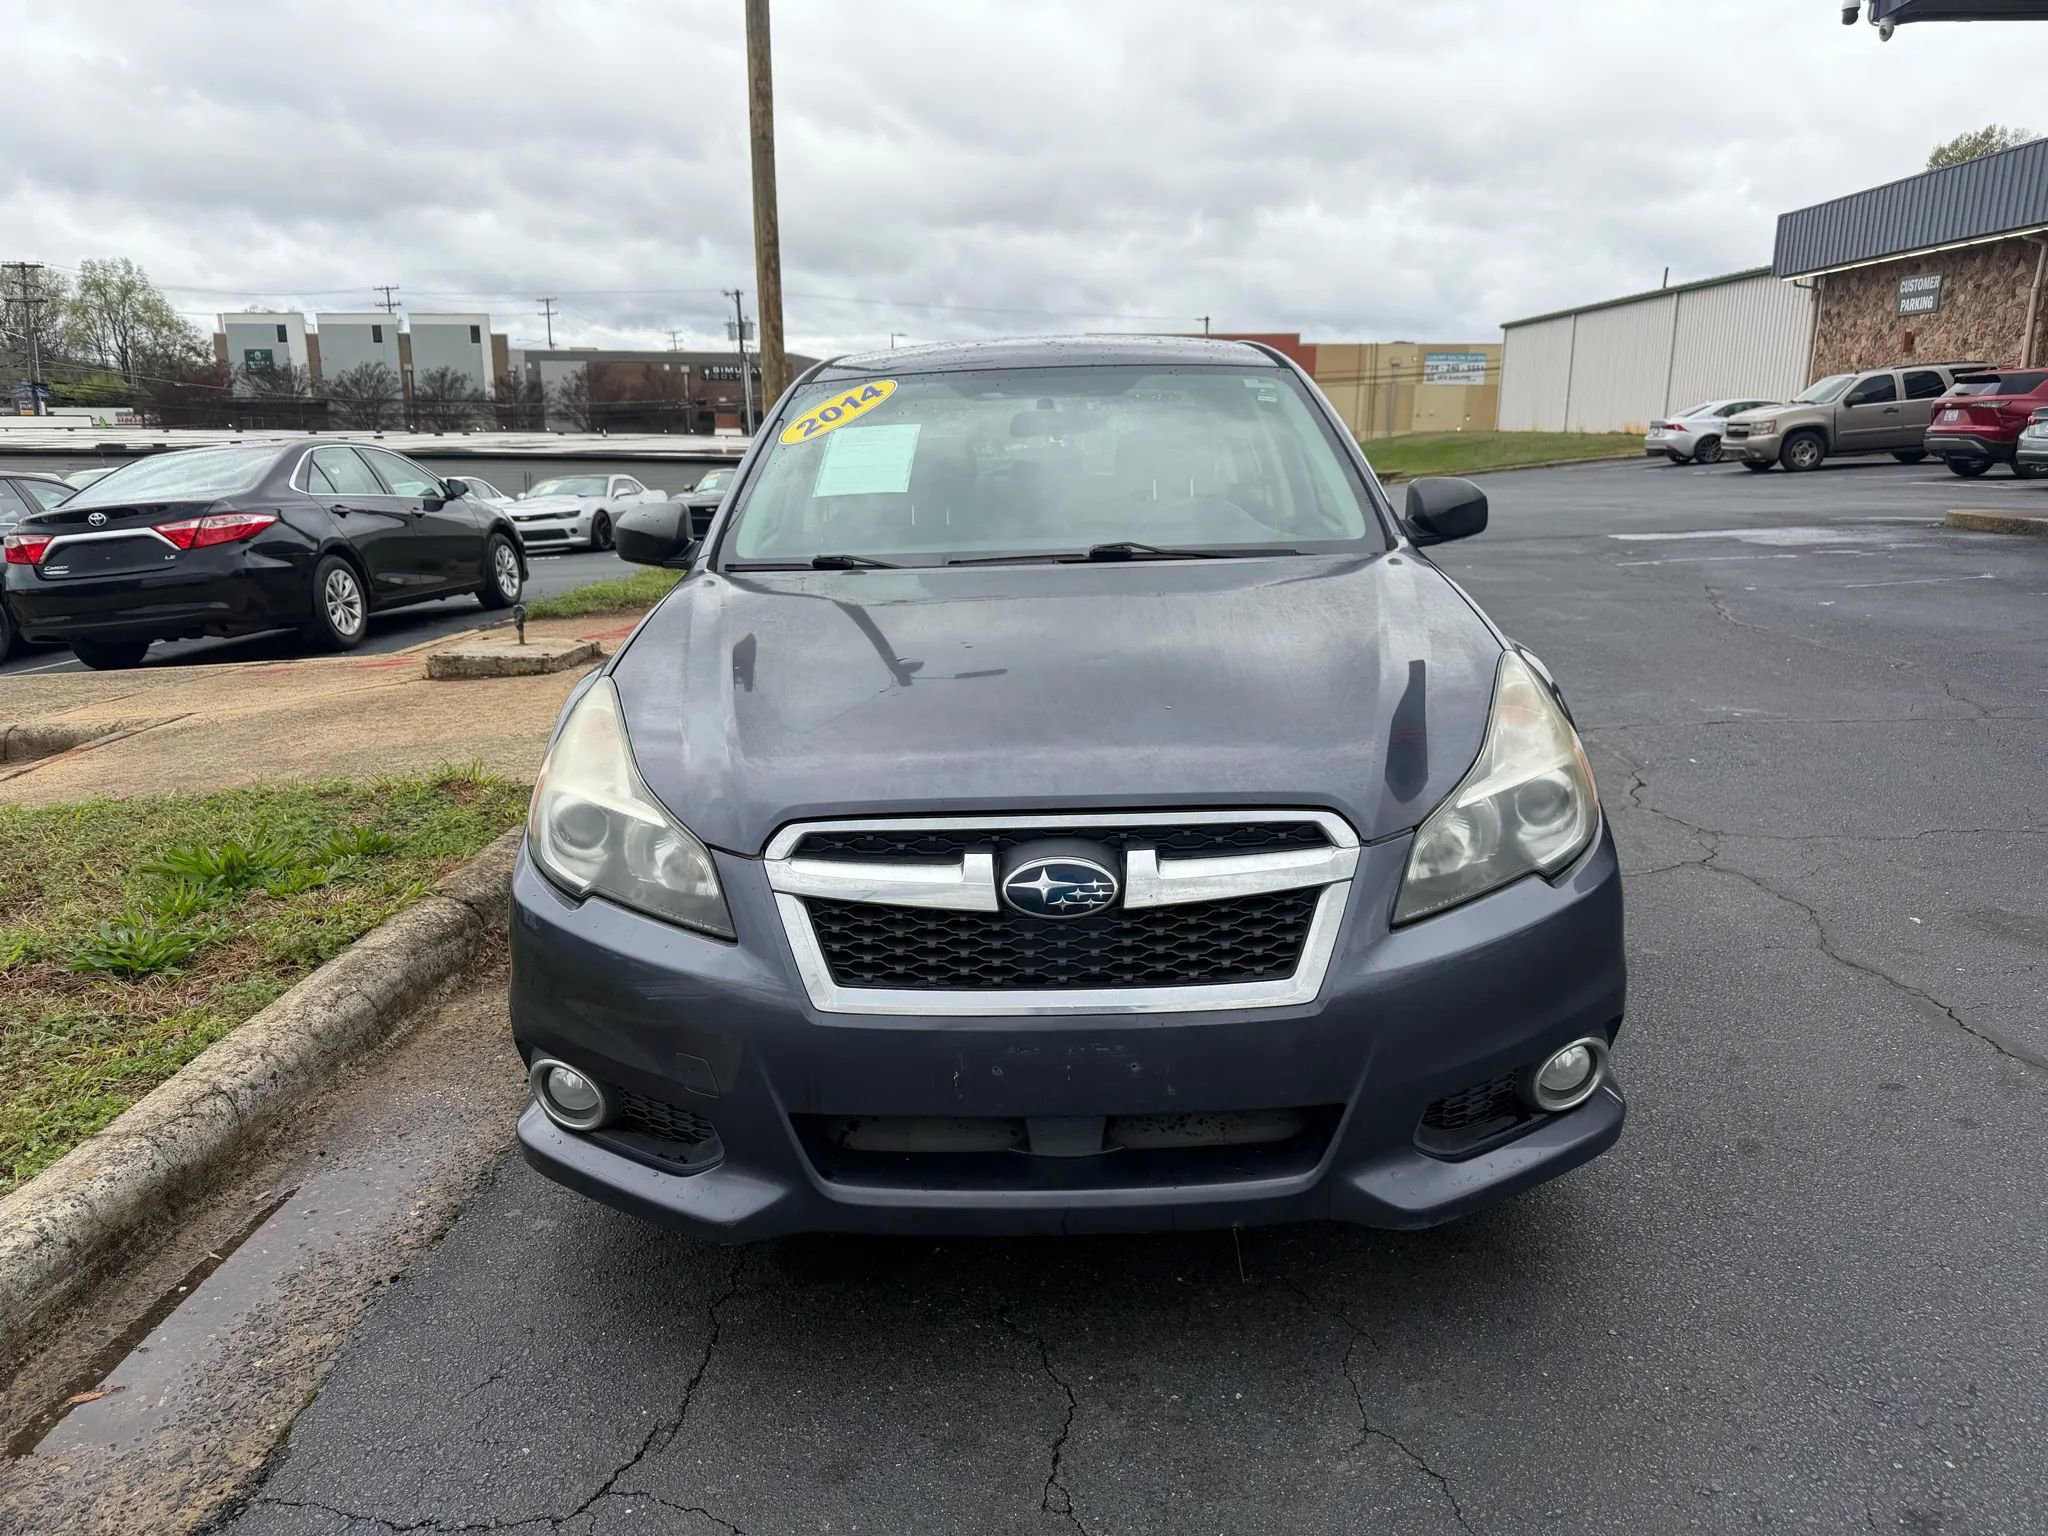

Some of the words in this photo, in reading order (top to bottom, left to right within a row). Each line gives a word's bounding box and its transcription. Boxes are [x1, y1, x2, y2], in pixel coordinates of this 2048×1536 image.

[1900, 275, 1940, 293] CUSTOMER
[1900, 296, 1933, 312] PARKING
[796, 385, 884, 437] 2014
